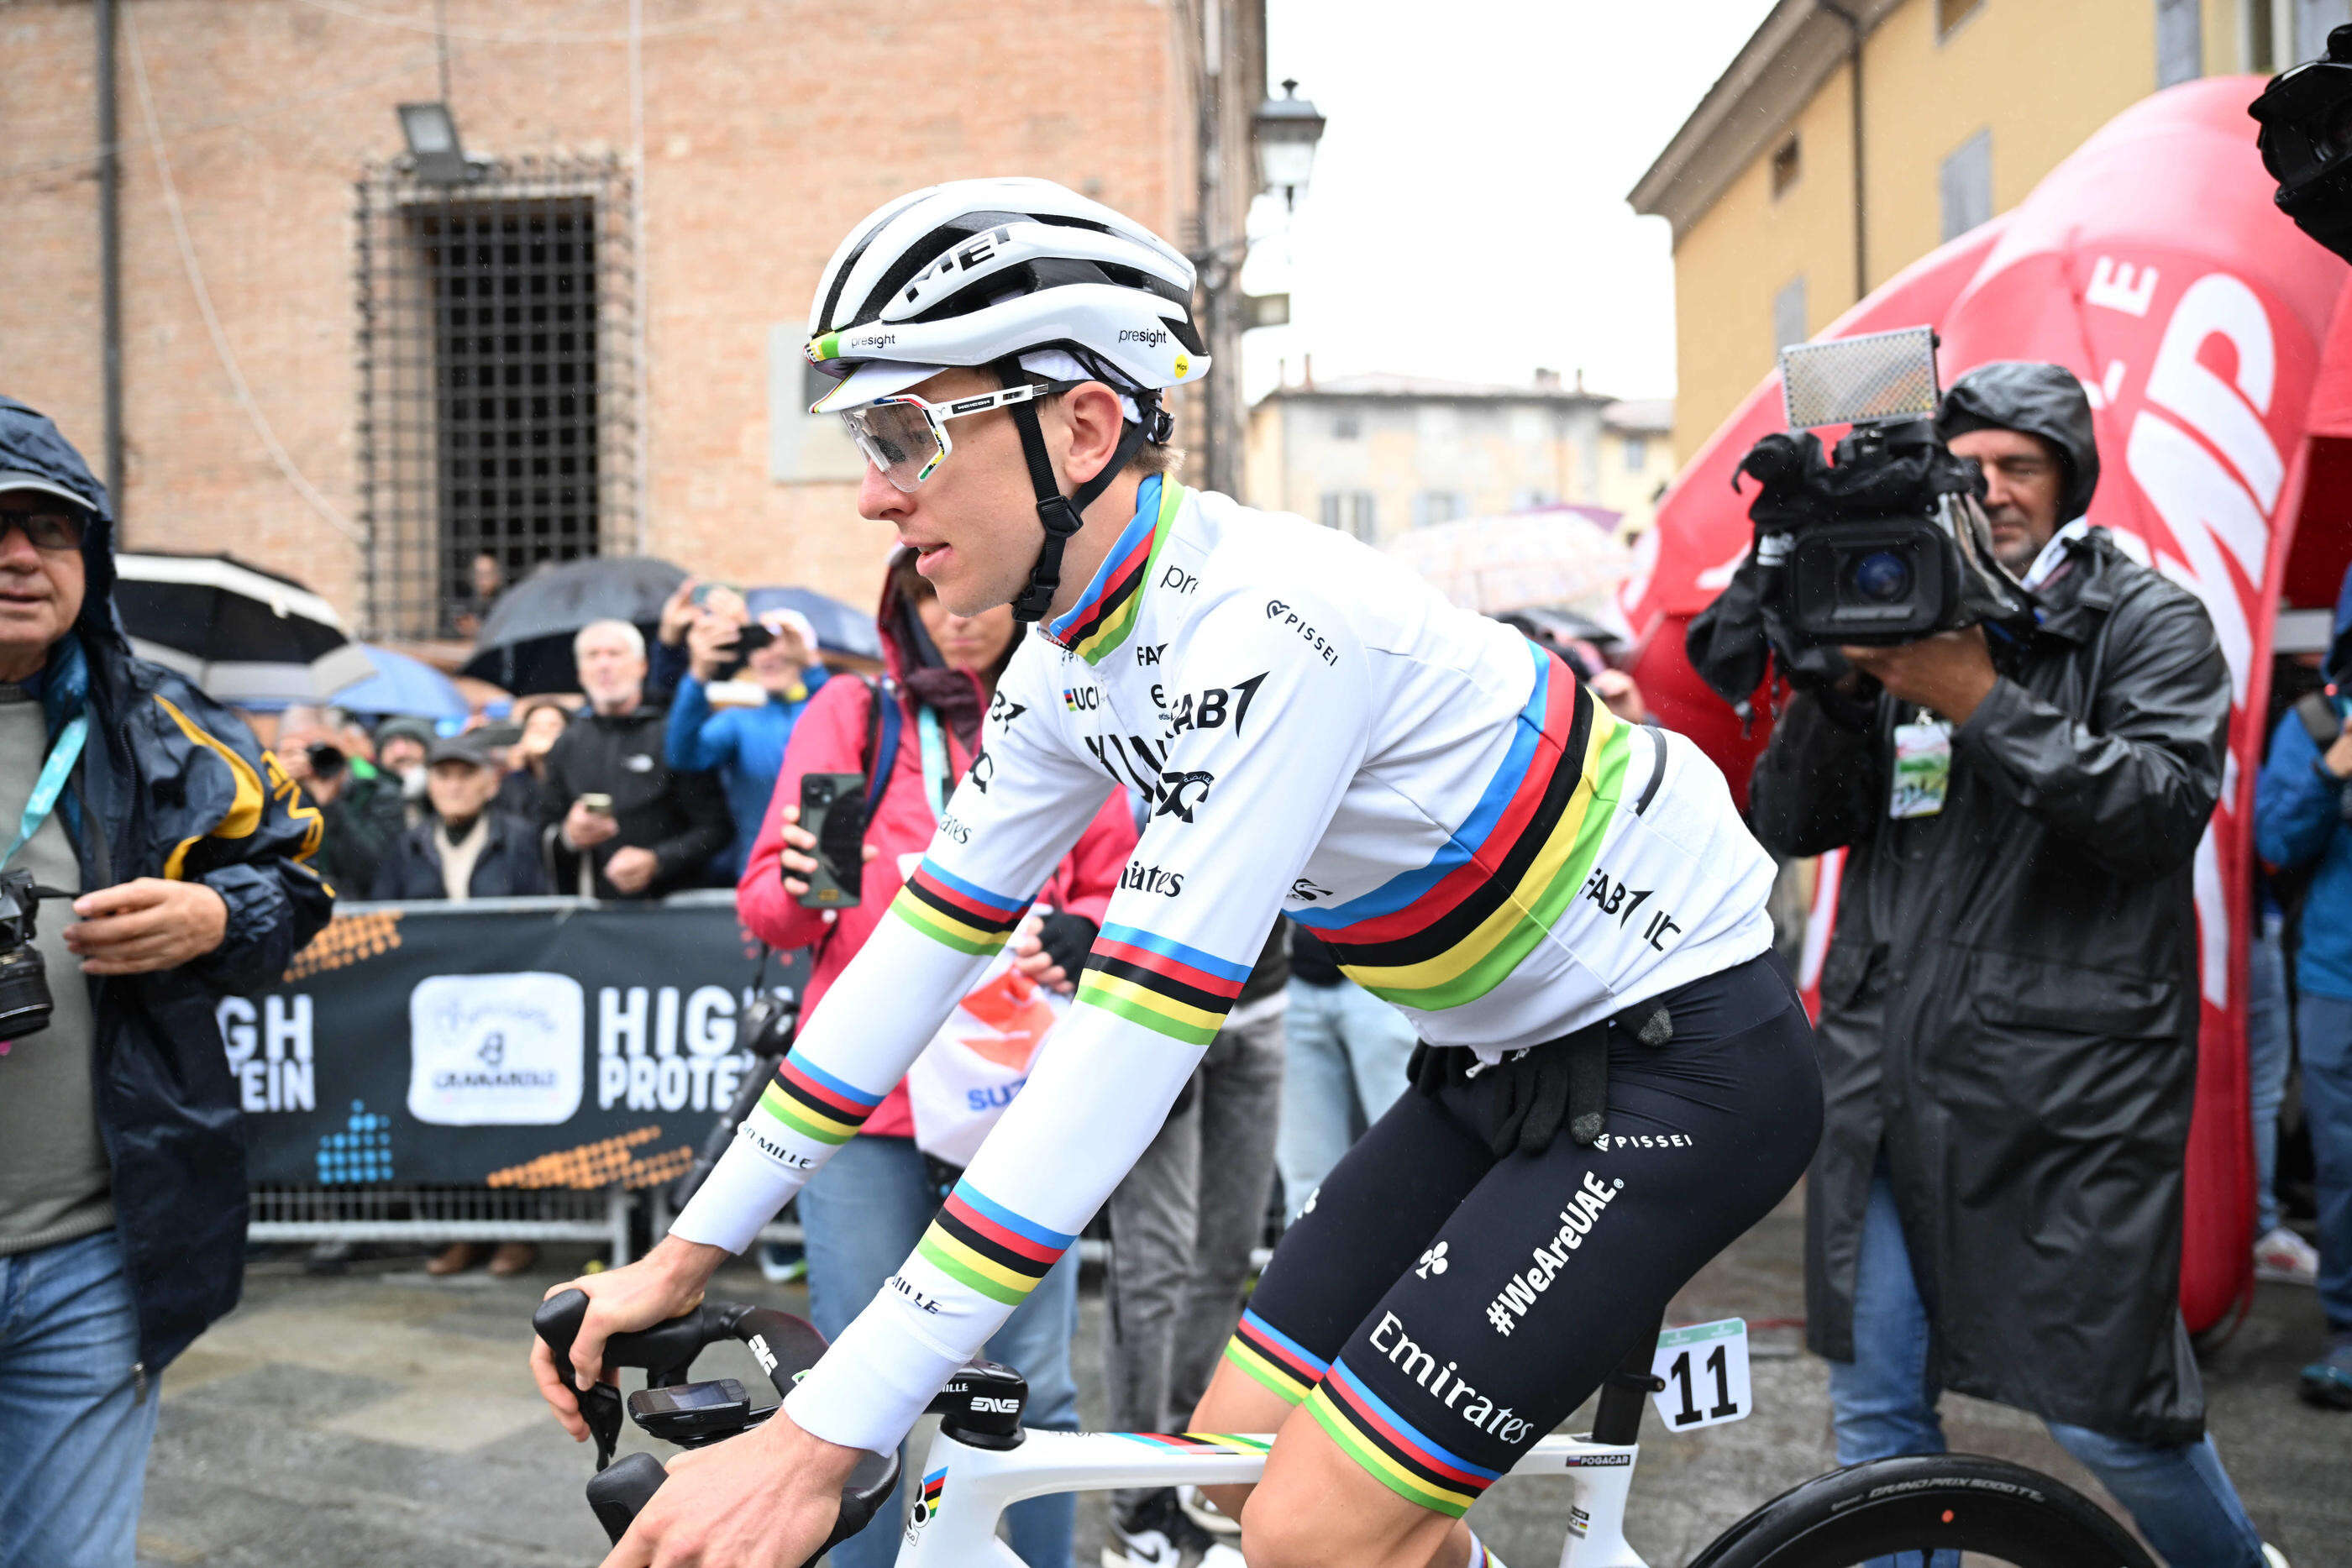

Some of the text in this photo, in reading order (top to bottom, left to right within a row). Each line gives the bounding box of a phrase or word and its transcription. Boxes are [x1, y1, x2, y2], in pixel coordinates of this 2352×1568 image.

[851, 334, 895, 349] presight
[1117, 328, 1167, 348] presight
[1284, 612, 1339, 667] PISSEI
[215, 994, 314, 1062] GH
[598, 985, 795, 1058] HIG
[230, 1059, 317, 1113] EIN
[1614, 1134, 1693, 1148] PISSEI
[1368, 1309, 1535, 1445] Emirates
[1671, 1344, 1738, 1426] 11
[1868, 1479, 1929, 1499] GRAND
[1929, 1477, 1971, 1488] PRIX
